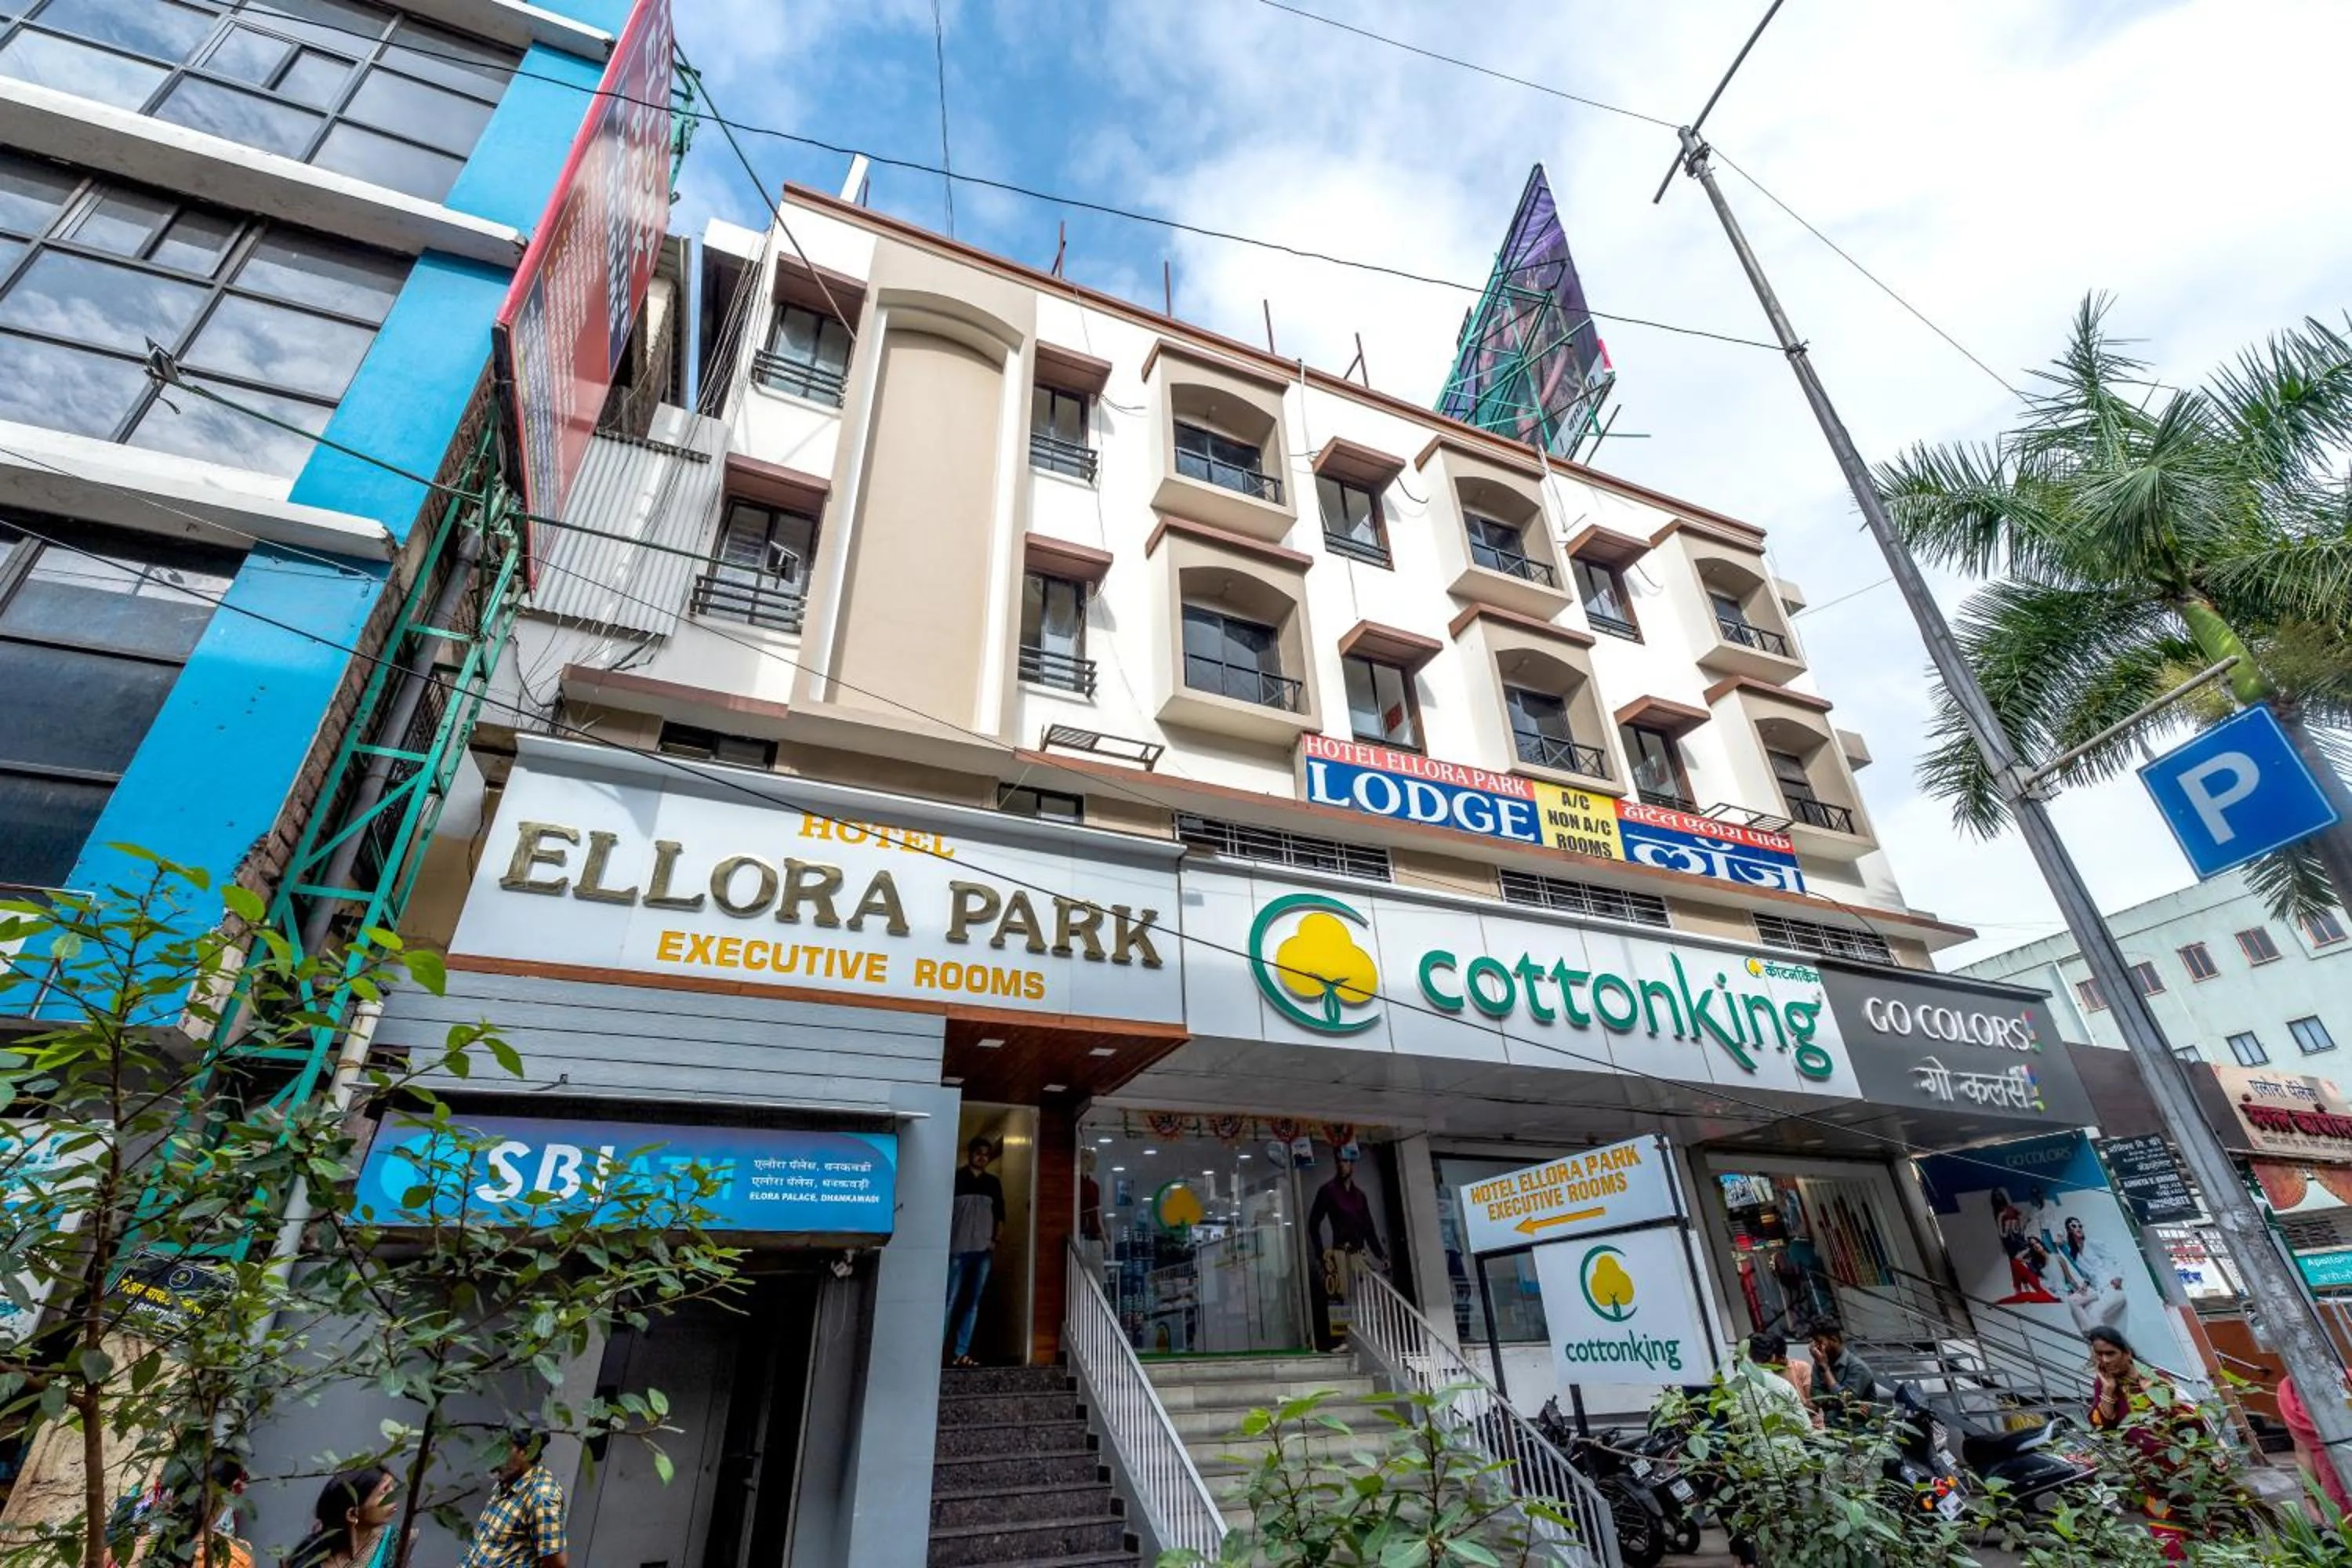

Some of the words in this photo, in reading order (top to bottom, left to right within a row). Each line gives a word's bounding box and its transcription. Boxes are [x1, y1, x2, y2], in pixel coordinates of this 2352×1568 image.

[1305, 736, 1381, 767] HOTEL
[1387, 752, 1468, 784] ELLORA
[1473, 769, 1528, 797] PARK
[1308, 760, 1535, 841] LODGE
[1548, 808, 1581, 830] NON
[1583, 815, 1612, 837] A/C
[1561, 791, 1590, 810] A/C
[2176, 751, 2260, 845] P
[798, 811, 955, 859] HOTEL
[1555, 832, 1613, 857] ROOMS
[499, 821, 909, 937] ELLORA
[945, 880, 1164, 969] PARK
[1625, 837, 1807, 896] लॉज
[656, 931, 888, 984] EXECUTIVE
[914, 958, 1046, 1000] ROOMS
[1418, 951, 1835, 1080] cottonking
[1865, 996, 1912, 1036] GO
[1917, 1004, 2030, 1051] COLORS
[1911, 1055, 1955, 1102] गो
[474, 1141, 616, 1203] SBI
[750, 1191, 780, 1201] ELORA
[1470, 1178, 1517, 1205] HOTEL
[1519, 1160, 1584, 1191] ELLORA
[1584, 1144, 1642, 1176] PARK
[1487, 1188, 1564, 1221] EXECUTIVE
[1567, 1171, 1628, 1203] ROOMS
[1565, 1329, 1682, 1371] cottonking
